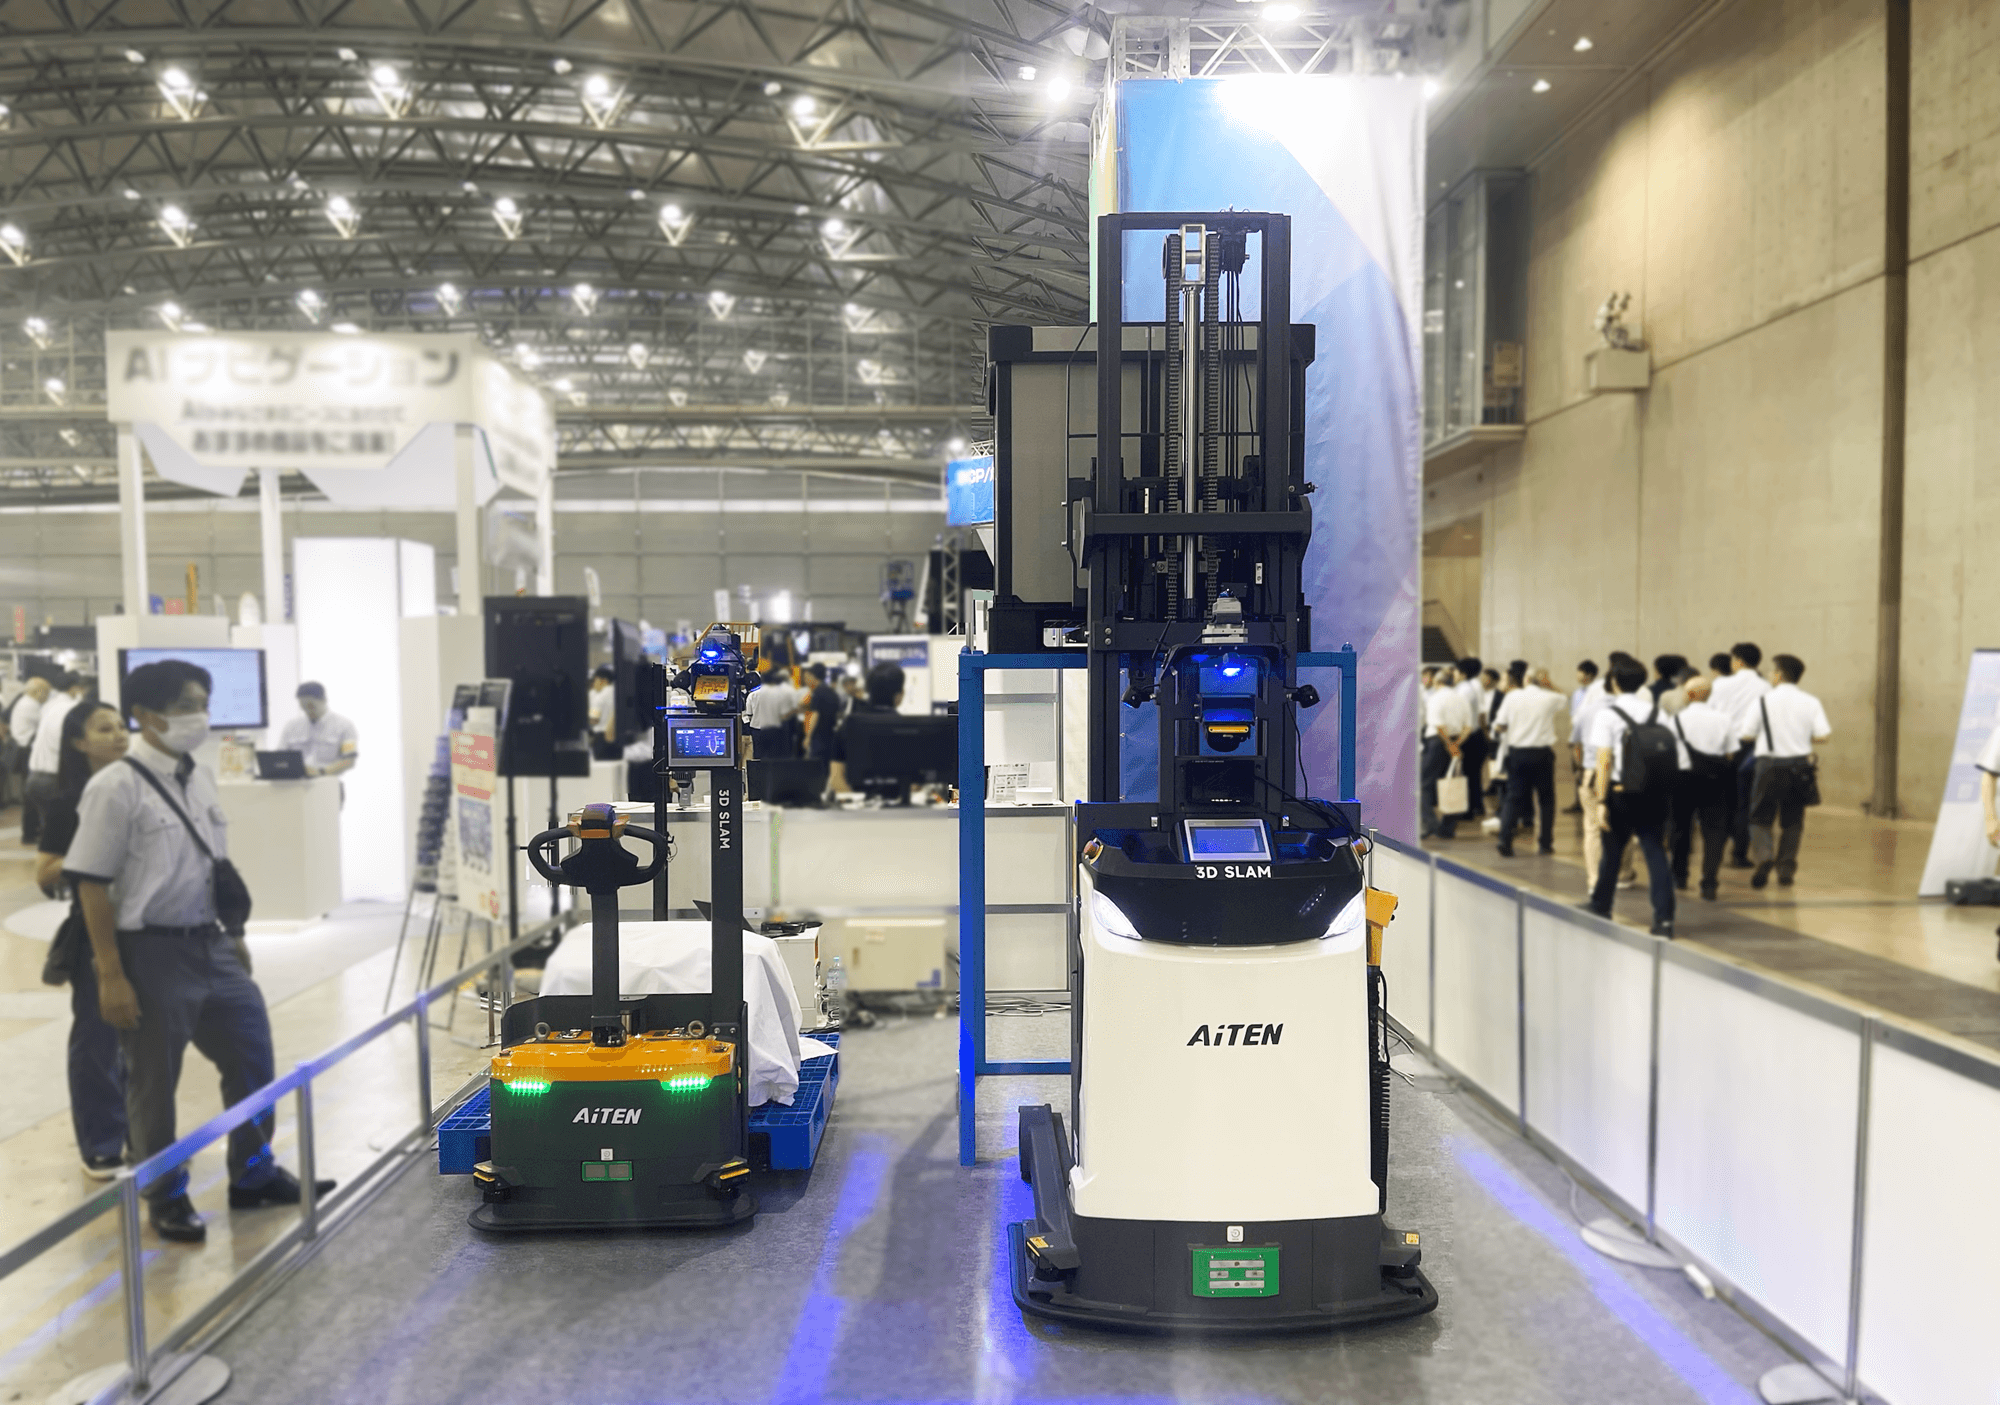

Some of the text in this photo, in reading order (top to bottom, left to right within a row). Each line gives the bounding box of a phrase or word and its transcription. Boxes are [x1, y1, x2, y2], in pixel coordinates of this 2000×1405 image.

[718, 789, 731, 849] 3D SLAM
[1196, 865, 1272, 879] 3D SLAM
[1186, 1023, 1284, 1046] AiTEN
[572, 1107, 642, 1125] AiTEN
